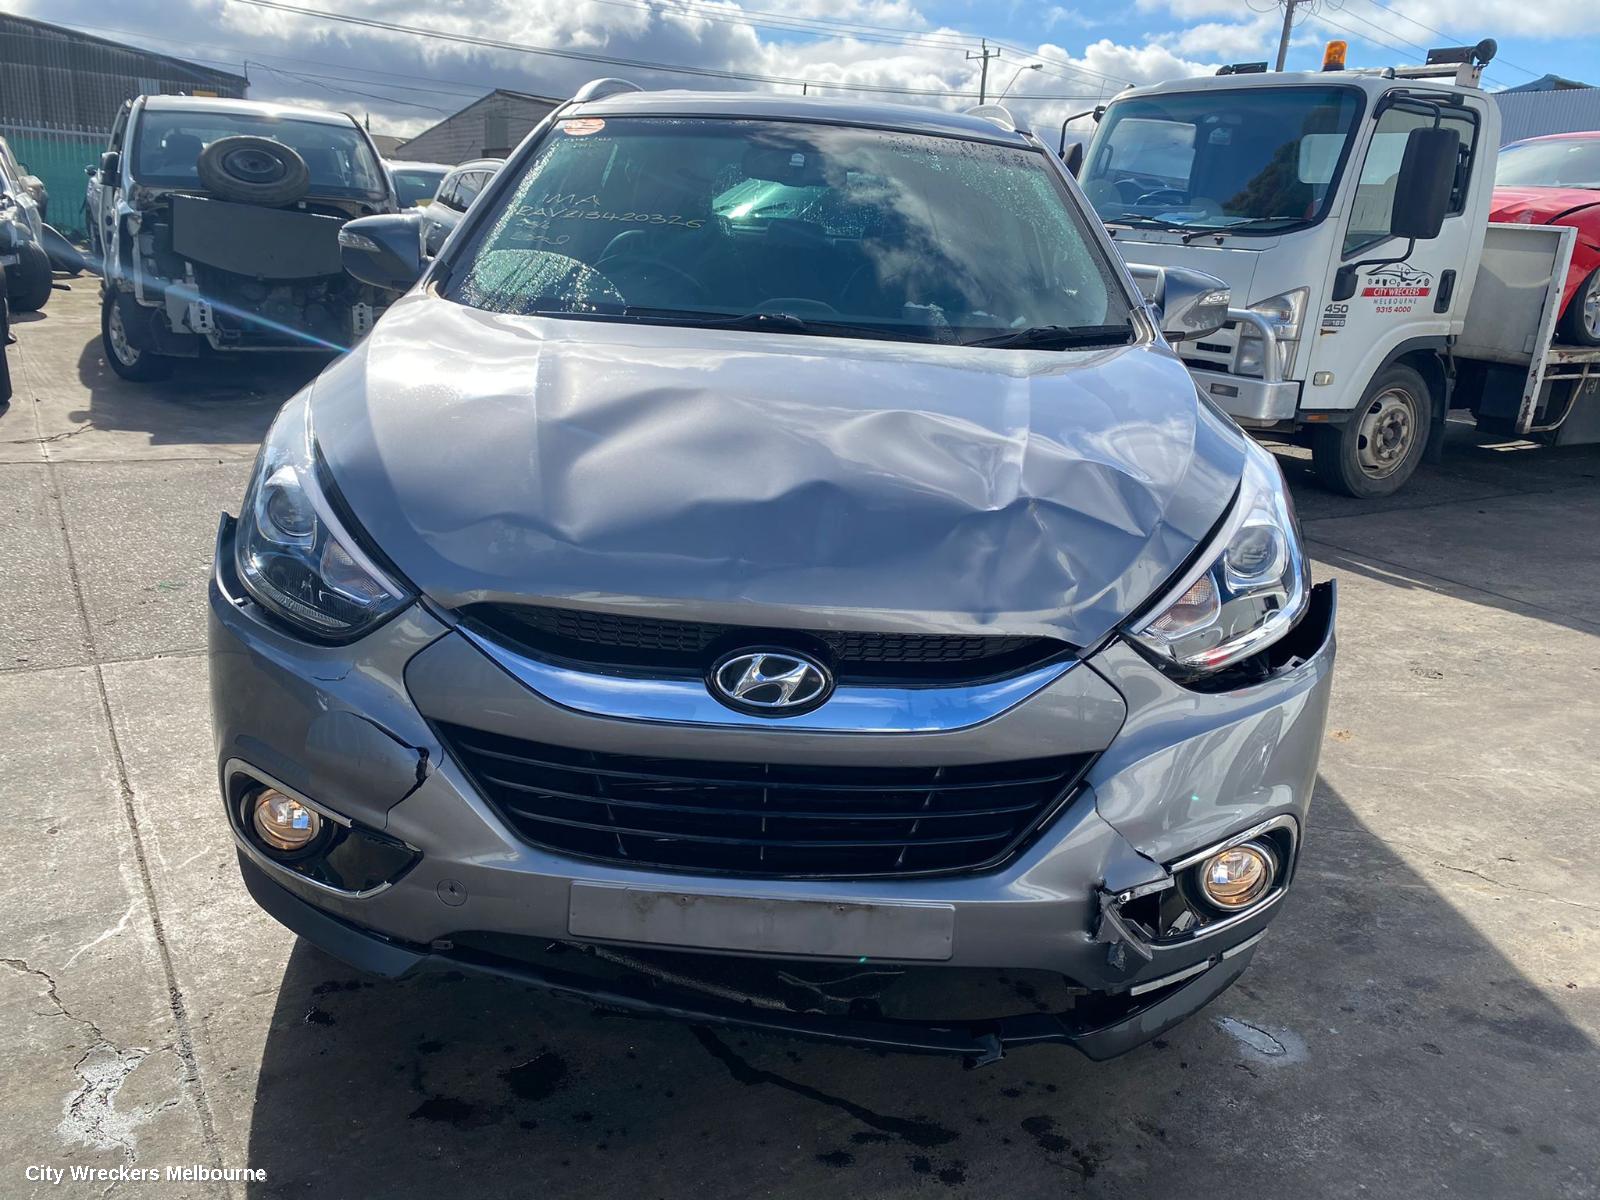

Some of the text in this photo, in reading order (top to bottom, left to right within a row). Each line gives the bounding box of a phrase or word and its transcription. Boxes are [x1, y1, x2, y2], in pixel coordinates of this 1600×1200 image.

[1373, 287, 1420, 296] CITY WRECKERS
[1324, 304, 1349, 313] 450
